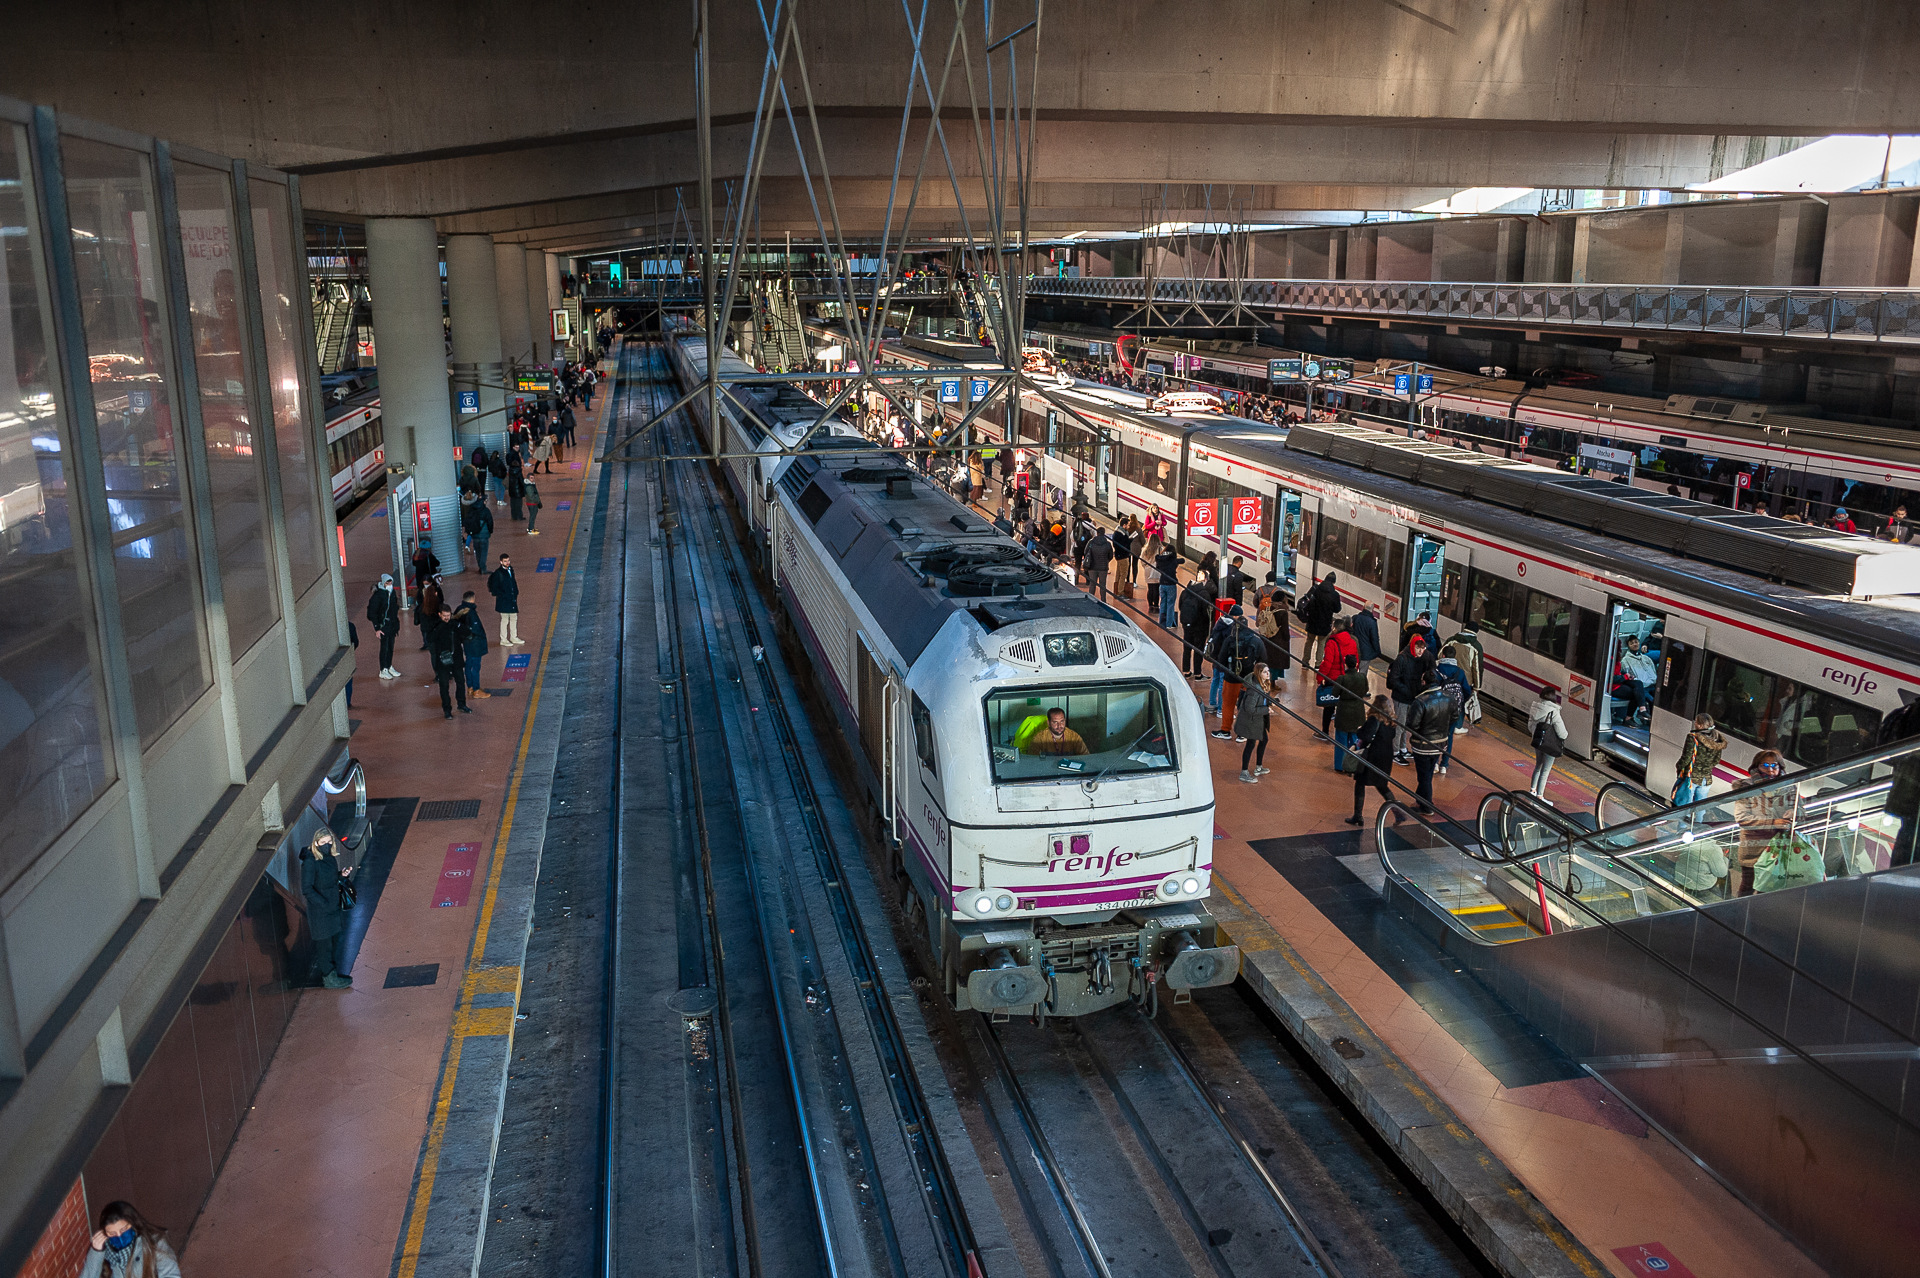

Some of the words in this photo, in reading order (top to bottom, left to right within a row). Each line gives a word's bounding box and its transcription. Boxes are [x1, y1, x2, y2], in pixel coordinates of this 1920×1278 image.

[1199, 510, 1208, 522] F
[1242, 508, 1251, 521] F
[1821, 666, 1878, 696] renfe
[923, 803, 946, 847] renfe
[1048, 845, 1134, 878] renfe
[1648, 1259, 1667, 1269] E
